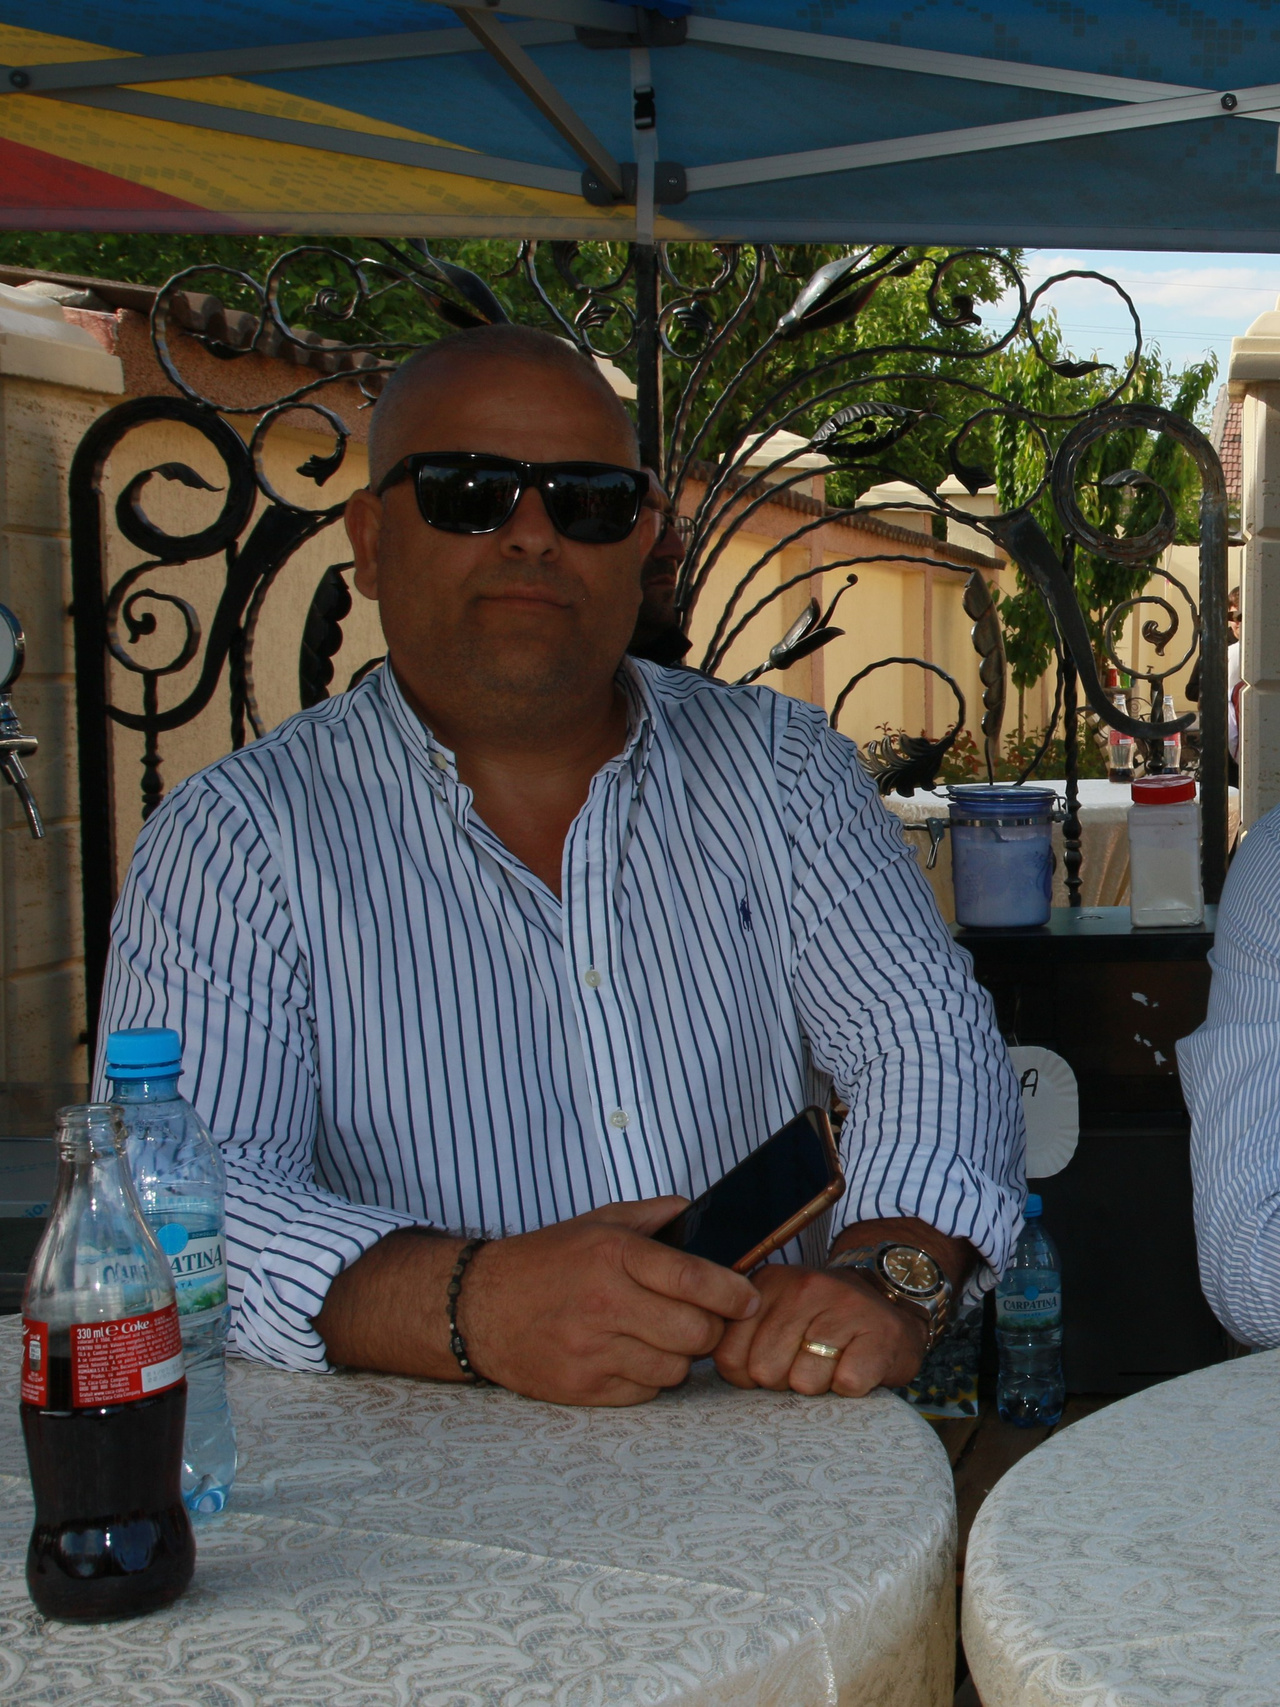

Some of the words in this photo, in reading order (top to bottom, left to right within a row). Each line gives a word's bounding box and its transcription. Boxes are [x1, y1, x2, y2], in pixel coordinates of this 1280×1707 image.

[1020, 1068, 1039, 1097] A
[1003, 1296, 1057, 1310] CARPATINA
[76, 1328, 92, 1339] 330
[93, 1326, 104, 1338] ml
[121, 1320, 150, 1334] Coke
